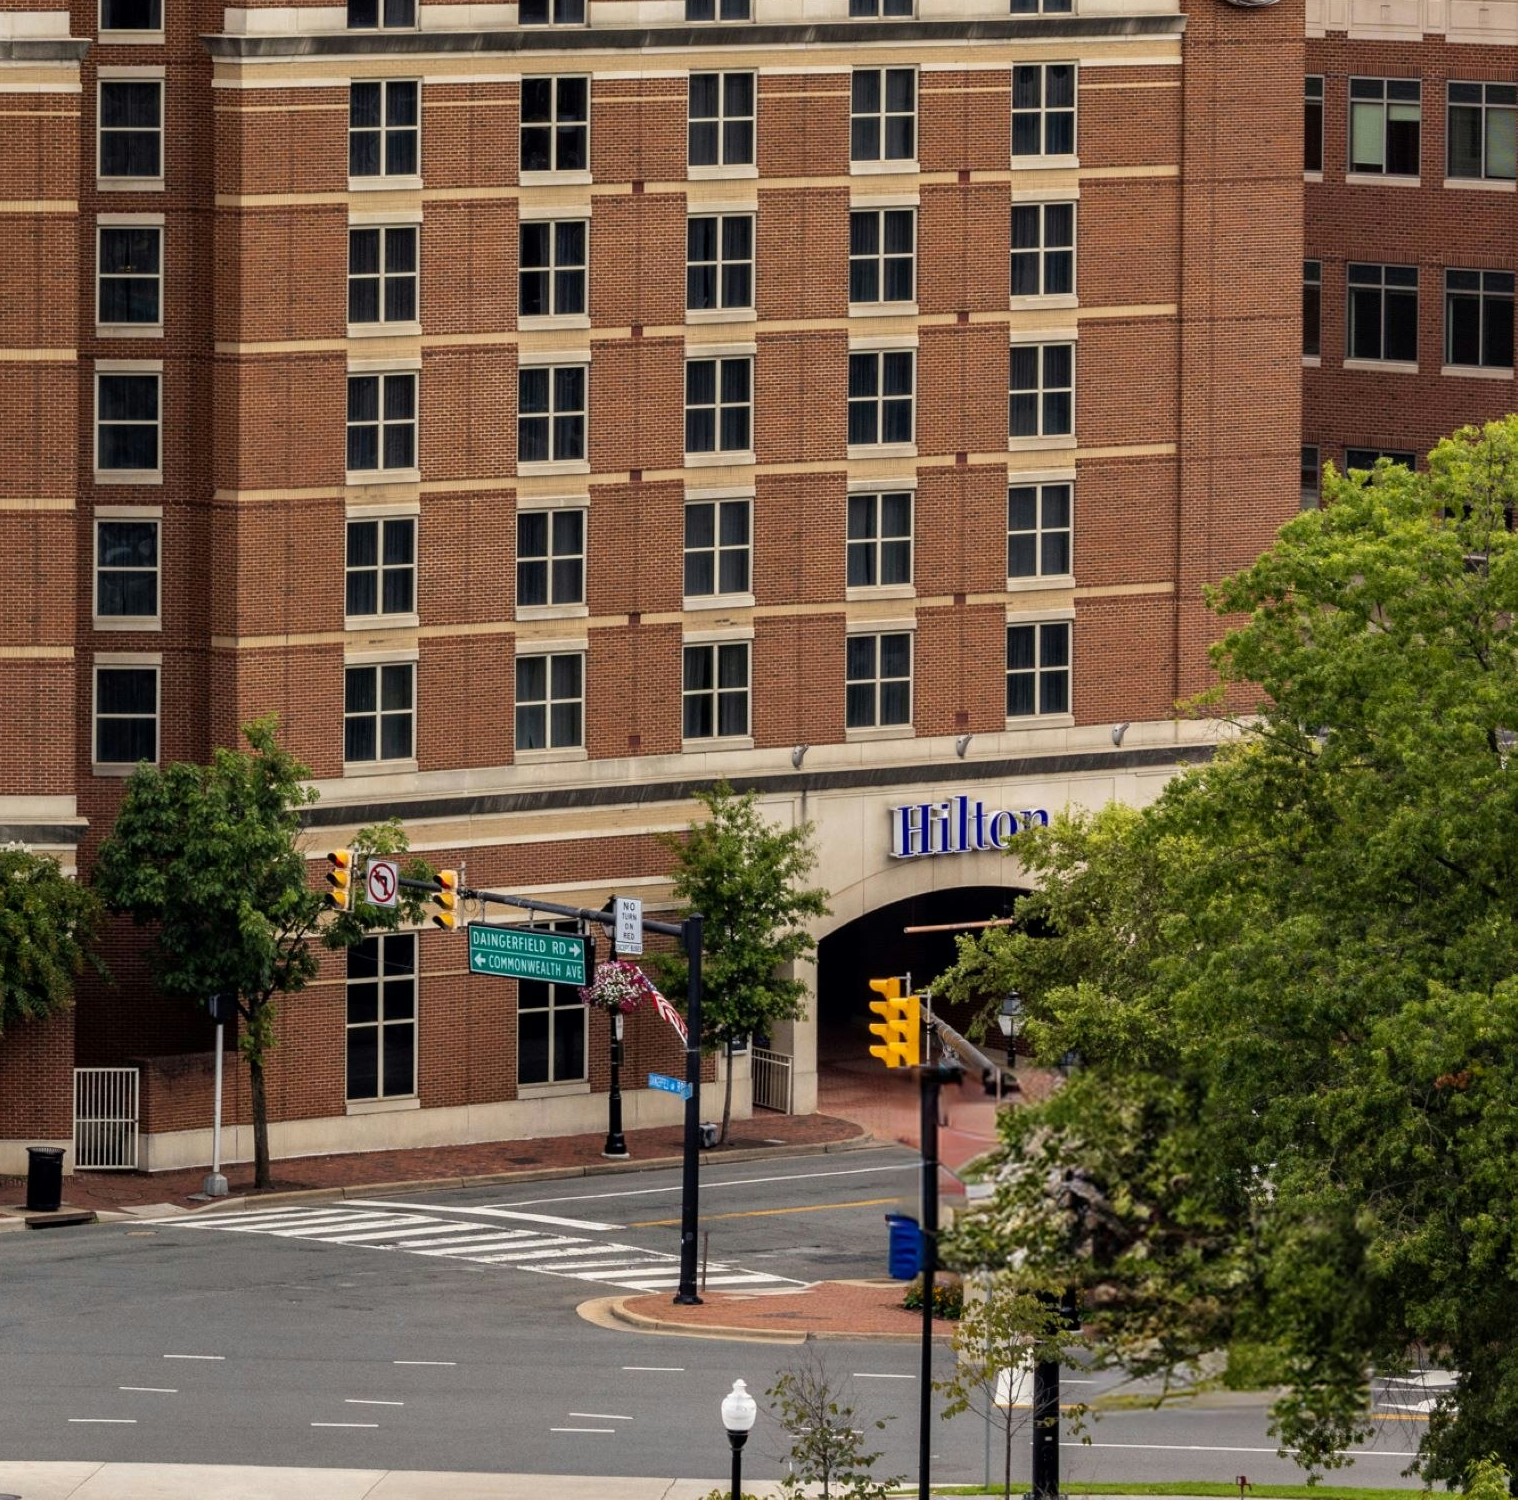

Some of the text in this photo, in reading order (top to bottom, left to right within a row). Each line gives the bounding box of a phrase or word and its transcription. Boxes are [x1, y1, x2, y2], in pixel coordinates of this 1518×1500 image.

[623, 902, 635, 911] NO
[622, 912, 637, 920] TURN
[624, 922, 634, 930] ON
[623, 932, 635, 940] RED
[473, 931, 567, 955] DAINGERFIELD RD
[489, 955, 582, 979] COMMONWEALTH AVE
